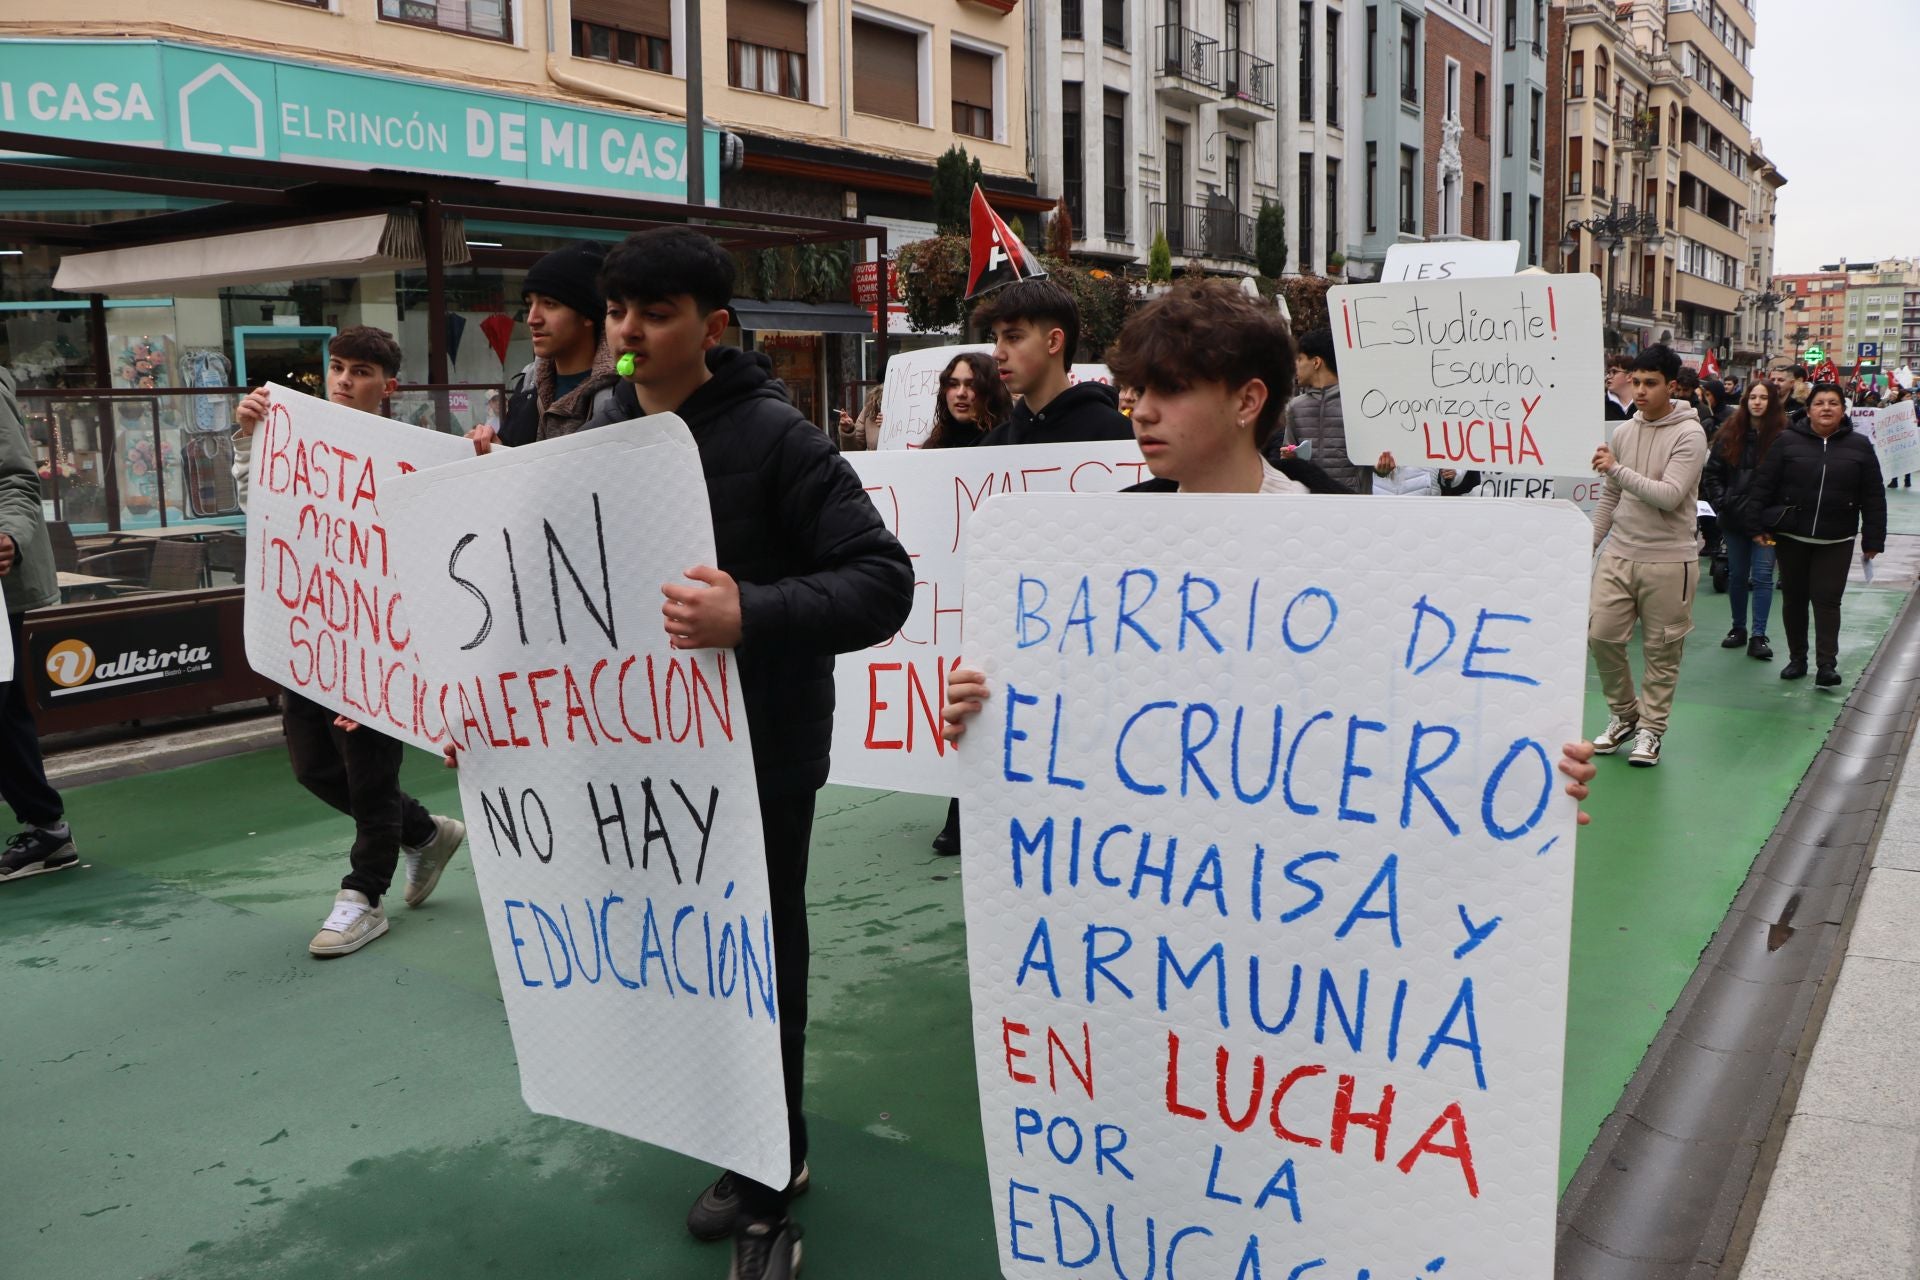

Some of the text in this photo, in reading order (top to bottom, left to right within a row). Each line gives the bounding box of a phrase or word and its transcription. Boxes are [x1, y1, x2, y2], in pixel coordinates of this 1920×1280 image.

[1, 82, 154, 121] I CASA
[466, 107, 526, 162] DE
[541, 117, 588, 170] MI
[1403, 262, 1456, 281] IES
[1862, 343, 1873, 357] P
[1424, 419, 1544, 466] LUCHA
[261, 515, 411, 652] ¡DADNO
[297, 504, 398, 579] MENT
[449, 492, 618, 651] SIN
[46, 643, 211, 686] Valkiria
[1015, 567, 1541, 687] BARRIO DE
[864, 655, 963, 759] EN
[1003, 683, 1558, 857] EL CRUCERO,
[481, 776, 719, 885] NO HAY
[1009, 816, 1403, 949] MICHAISA
[505, 880, 776, 1024] EDUCACIÓN
[1016, 917, 1488, 1092] ARMUNIA
[1002, 1017, 1481, 1199] EN LUCHA
[1014, 1106, 1304, 1225] POR LA
